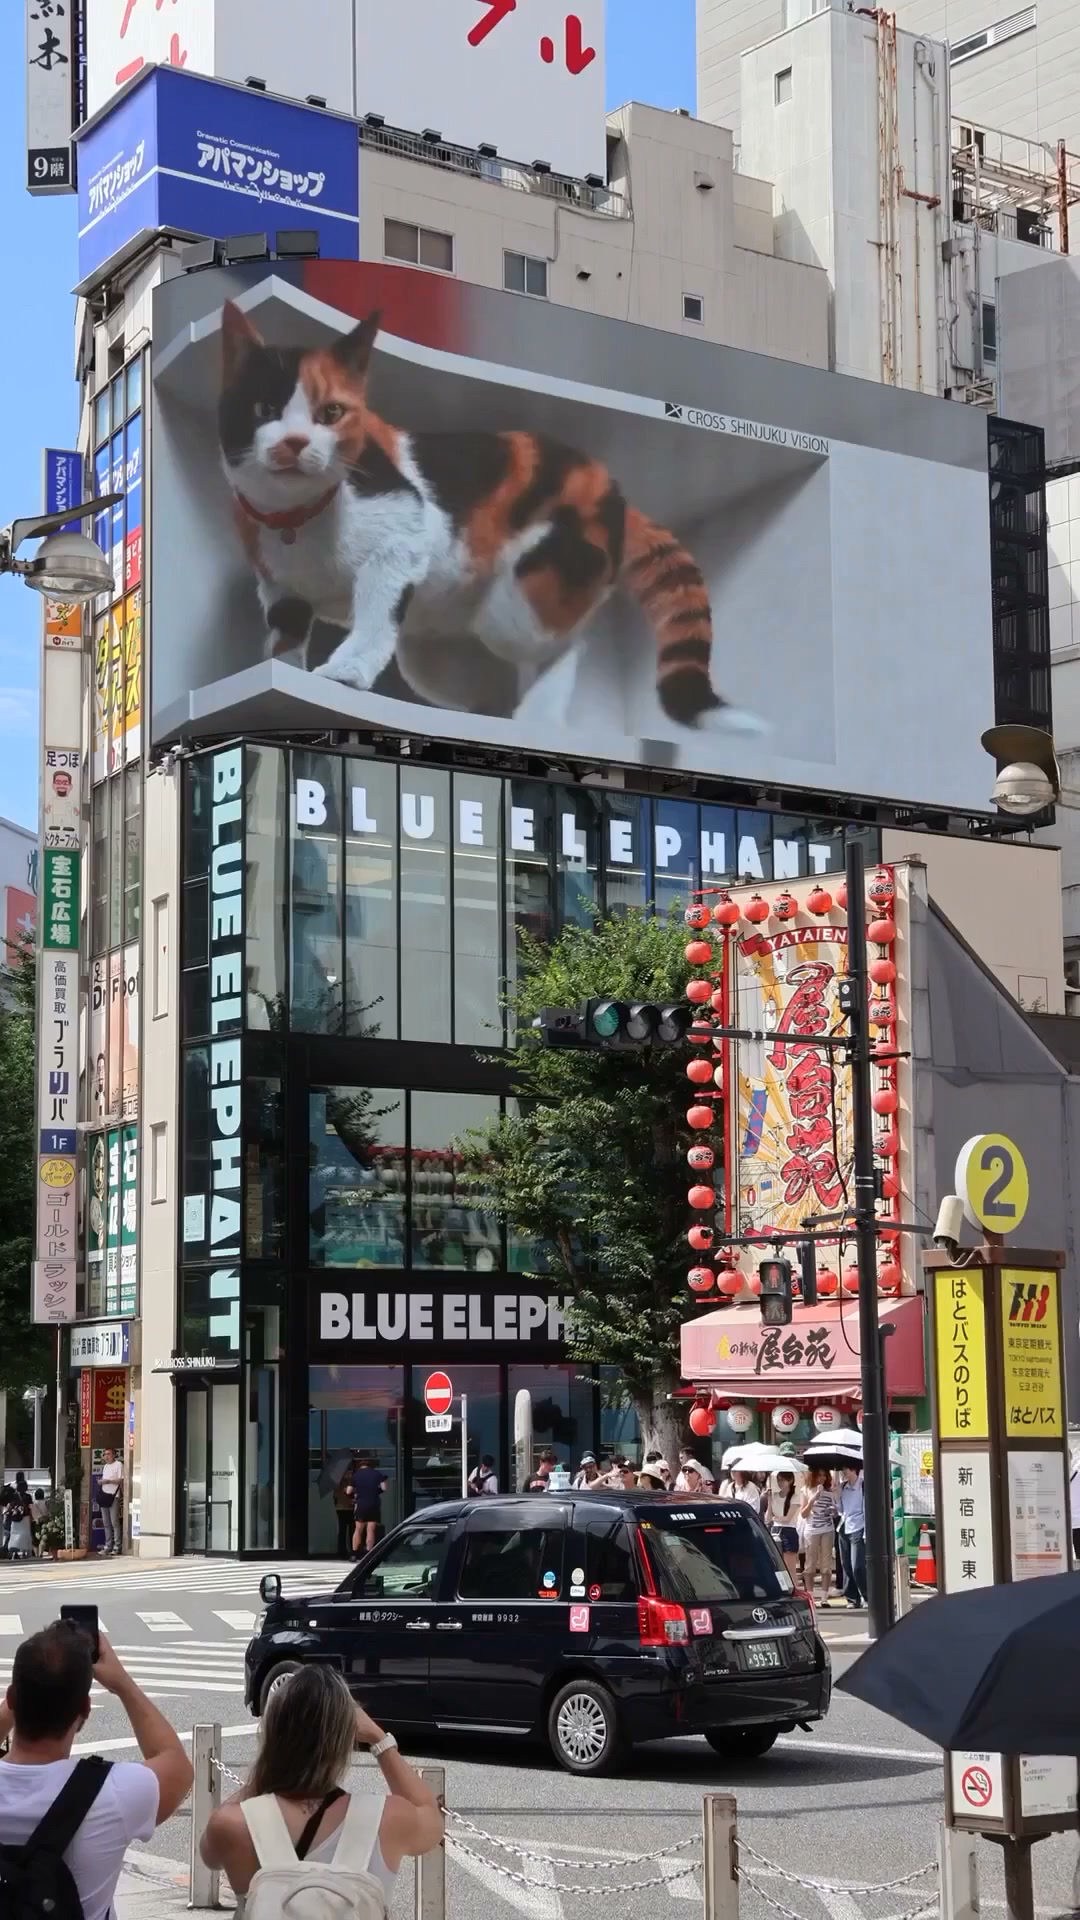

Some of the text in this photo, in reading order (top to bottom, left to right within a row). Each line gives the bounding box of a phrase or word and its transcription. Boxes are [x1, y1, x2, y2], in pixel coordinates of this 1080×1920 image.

[196, 130, 280, 159] Dramatic Communication
[197, 142, 326, 197] アパマンショップ
[88, 139, 145, 214] アパマンショップ
[687, 409, 829, 454] CROSS SHINJUKU VISION
[296, 779, 832, 880] BLUE ELEPHANT
[51, 855, 73, 945] 宝石広場
[767, 927, 847, 951] YATAIEN
[53, 961, 67, 1014] 高価買取
[49, 1019, 70, 1122] ブラリバ
[209, 747, 242, 1351] BLUE ELEPHANT
[51, 1134, 68, 1150] 1F
[981, 1145, 1016, 1217] 2
[43, 1192, 70, 1320] ゴールドラッシュ
[320, 1292, 434, 1341] BLUE
[186, 1356, 216, 1367] SHINJUKU
[753, 1327, 837, 1376] 屋台苑
[951, 1279, 971, 1428] はとバスのりば
[1008, 1337, 1053, 1351] 東京定期観光
[1010, 1405, 1056, 1425] はとバス
[957, 1466, 977, 1580] 新宿駅東
[497, 1613, 519, 1622] 9932
